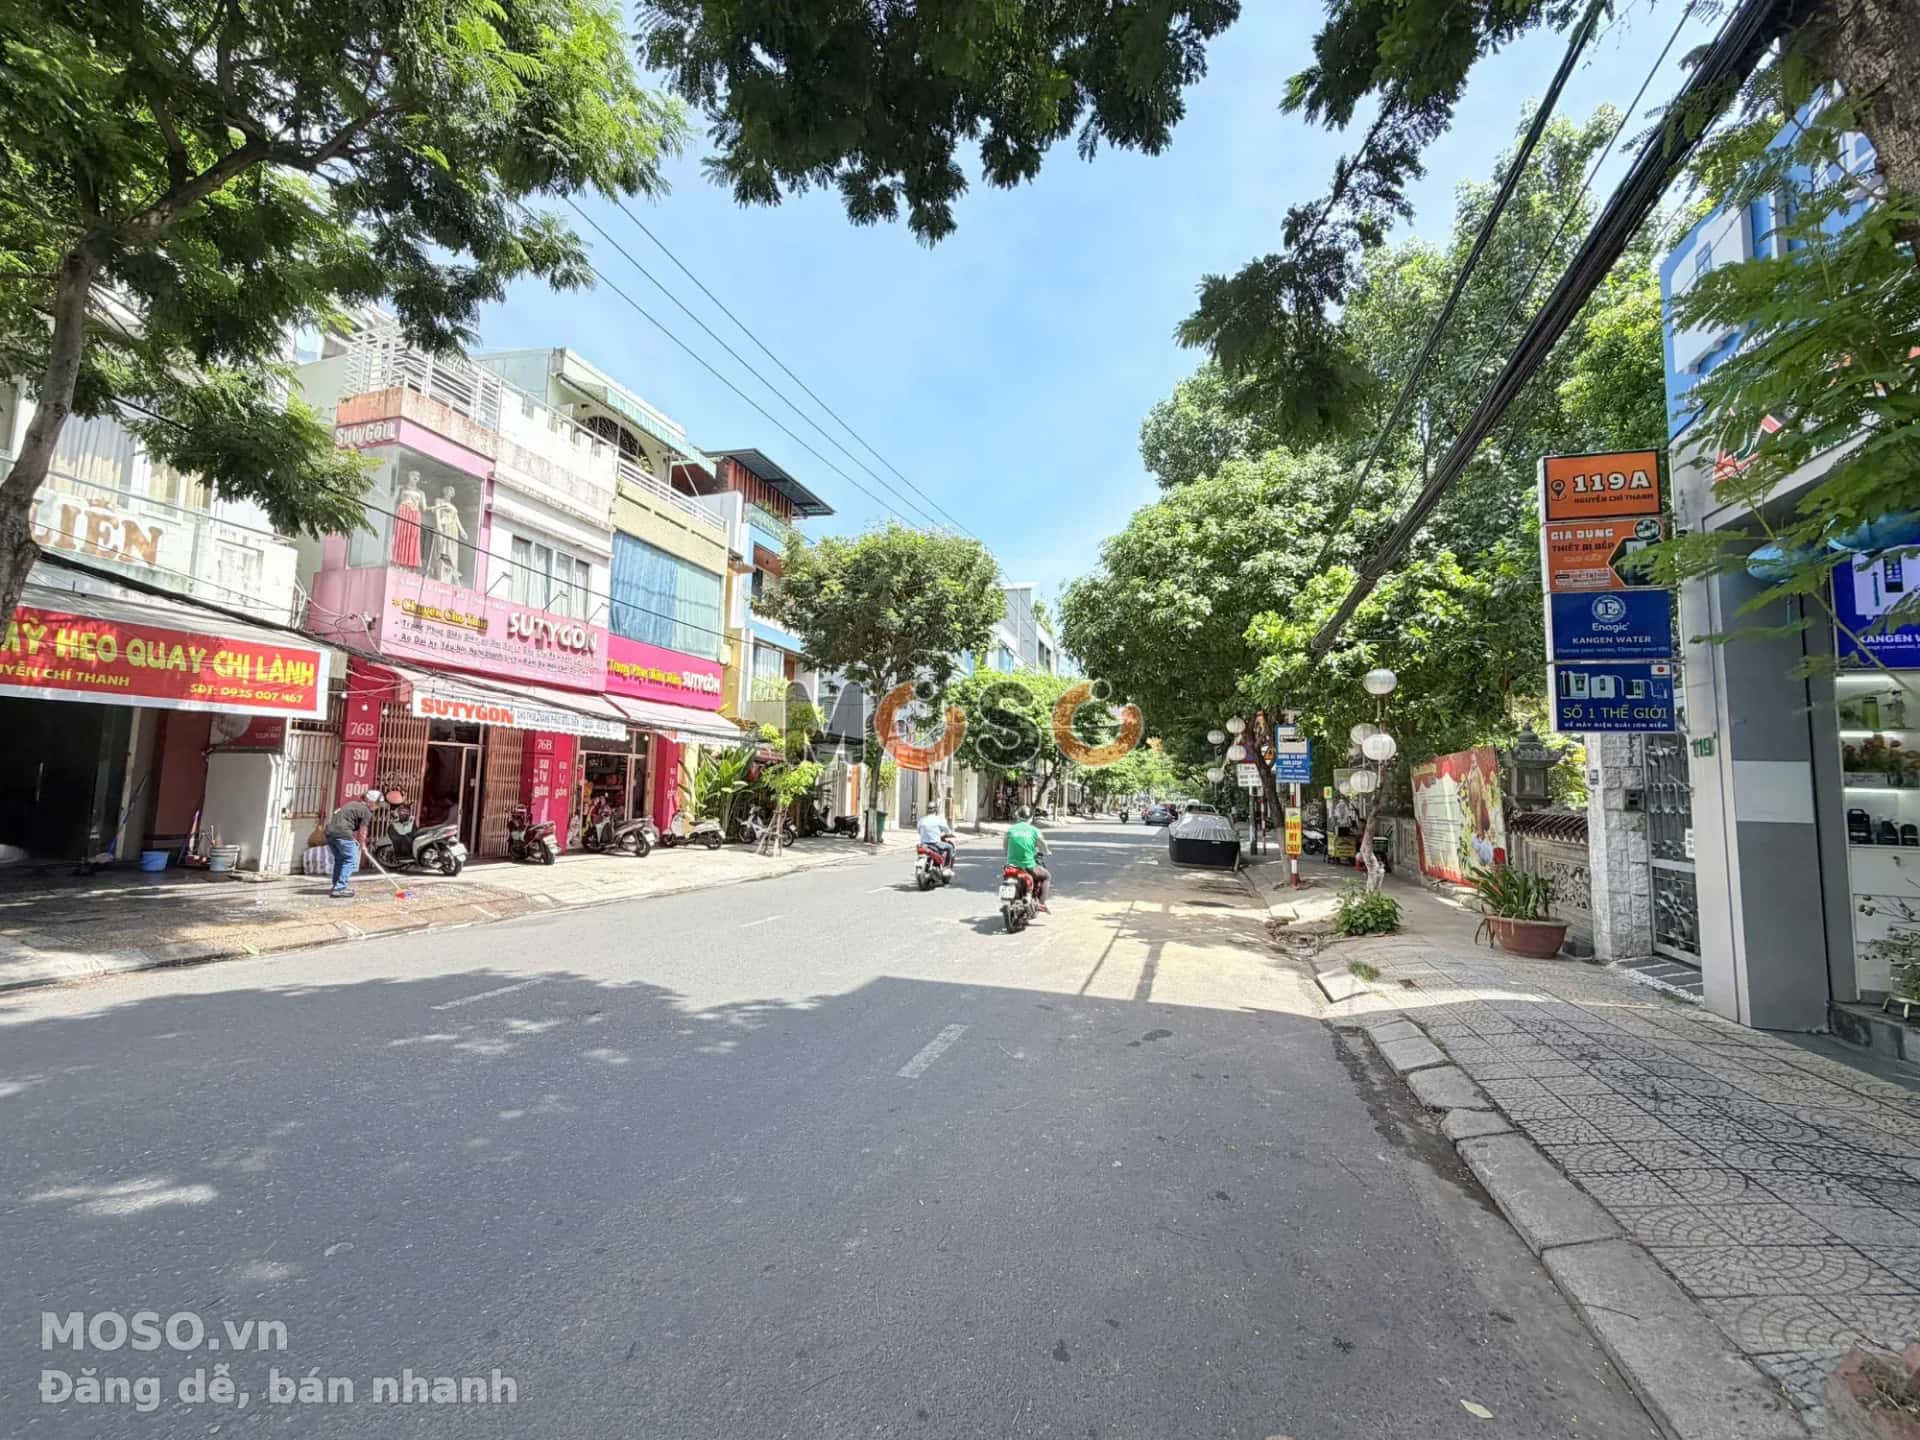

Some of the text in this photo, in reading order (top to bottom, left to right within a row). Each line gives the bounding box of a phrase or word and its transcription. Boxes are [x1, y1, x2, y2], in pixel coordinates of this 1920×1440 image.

[1573, 469, 1652, 493] 119A
[1572, 635, 1652, 645] KANGEN WATER
[55, 627, 118, 662] HEO
[126, 637, 207, 674] QUAY
[212, 649, 251, 685] CHỊ
[254, 652, 316, 688] LÀNH
[75, 671, 130, 687] THANH
[1588, 708, 1596, 718] 1
[350, 721, 374, 737] 76B
